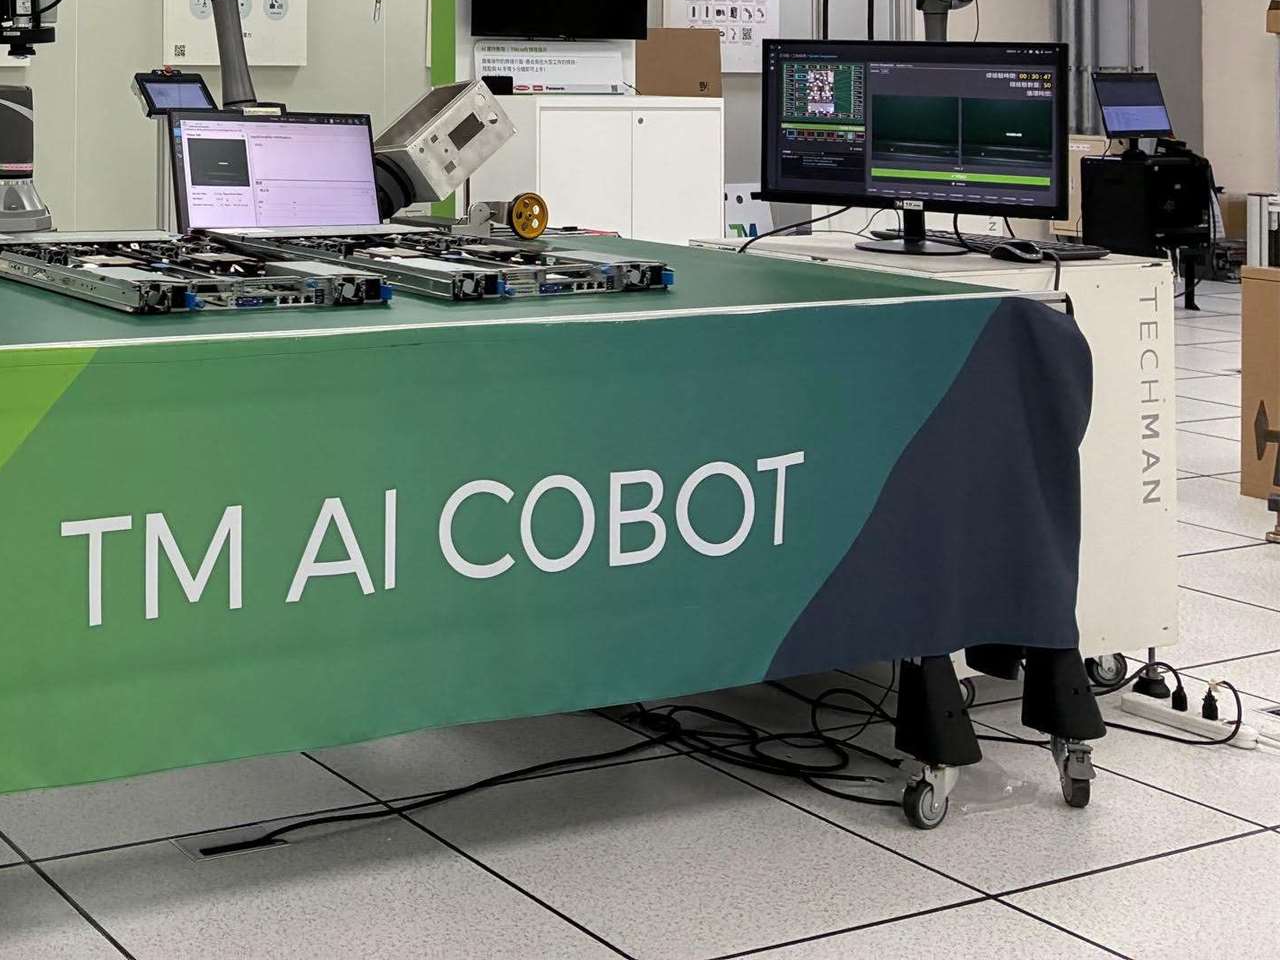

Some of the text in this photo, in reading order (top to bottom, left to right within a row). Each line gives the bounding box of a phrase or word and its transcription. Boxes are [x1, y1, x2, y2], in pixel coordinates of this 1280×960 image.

[1139, 286, 1161, 504] TECHMAN
[61, 451, 805, 627] TM AI COBOT
